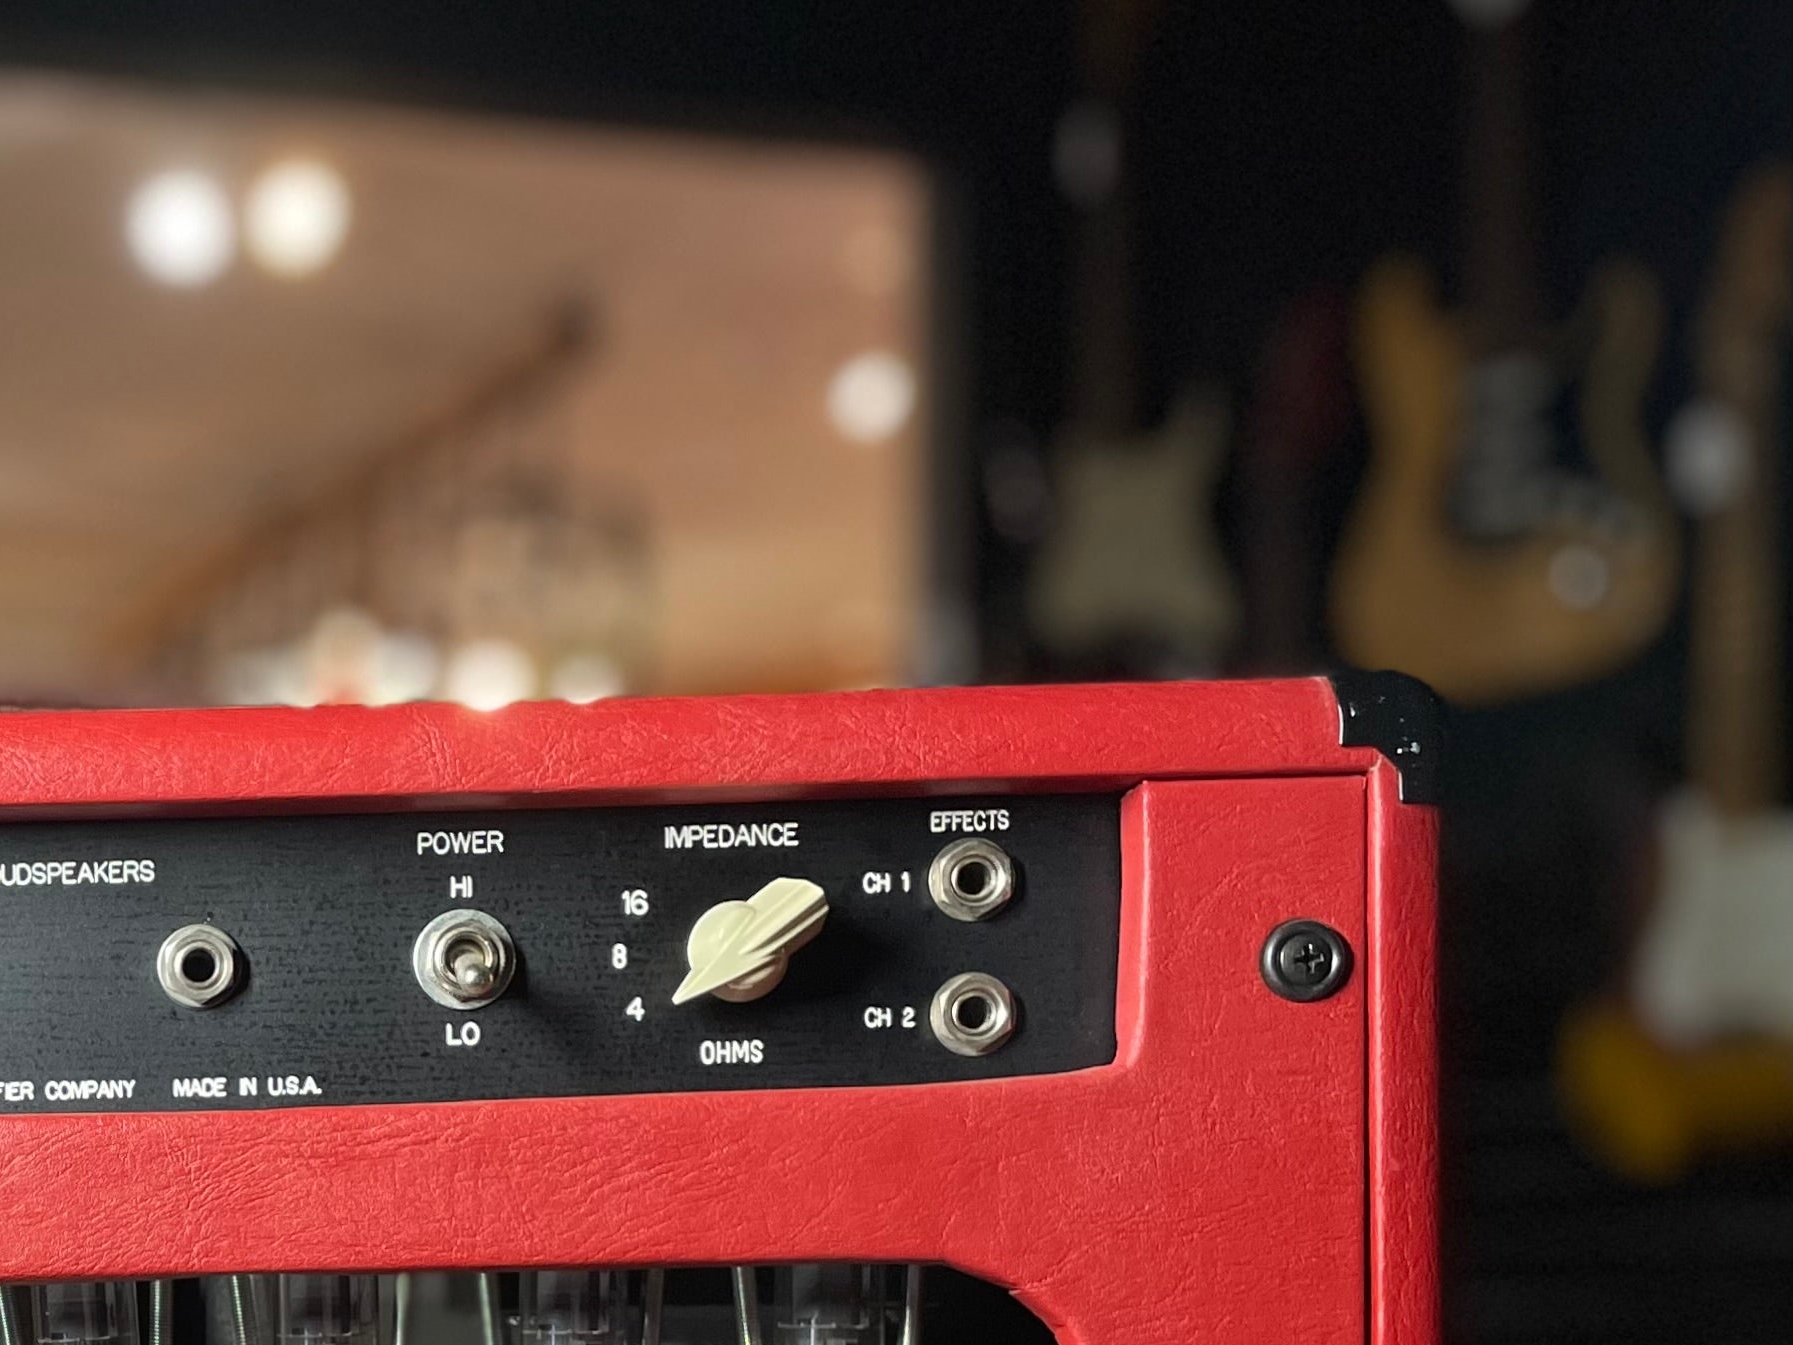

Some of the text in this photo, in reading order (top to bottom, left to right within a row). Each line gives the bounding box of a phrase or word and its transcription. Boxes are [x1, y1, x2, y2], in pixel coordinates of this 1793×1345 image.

[930, 809, 1010, 833] EFFECTS
[416, 830, 504, 856] POWER
[664, 822, 800, 849] IMPEDANCE
[449, 875, 473, 899] HI
[862, 871, 911, 895] CH 1
[621, 889, 650, 916] 16
[611, 943, 628, 970] 8
[625, 996, 646, 1022] 4
[863, 1006, 916, 1029] CH 2
[445, 1021, 481, 1047] LO
[699, 1039, 764, 1066] OHMS
[44, 1079, 136, 1101] COMPANY
[172, 1076, 228, 1098] MADE
[238, 1076, 258, 1097] IN
[267, 1075, 323, 1097] U.S.A.
